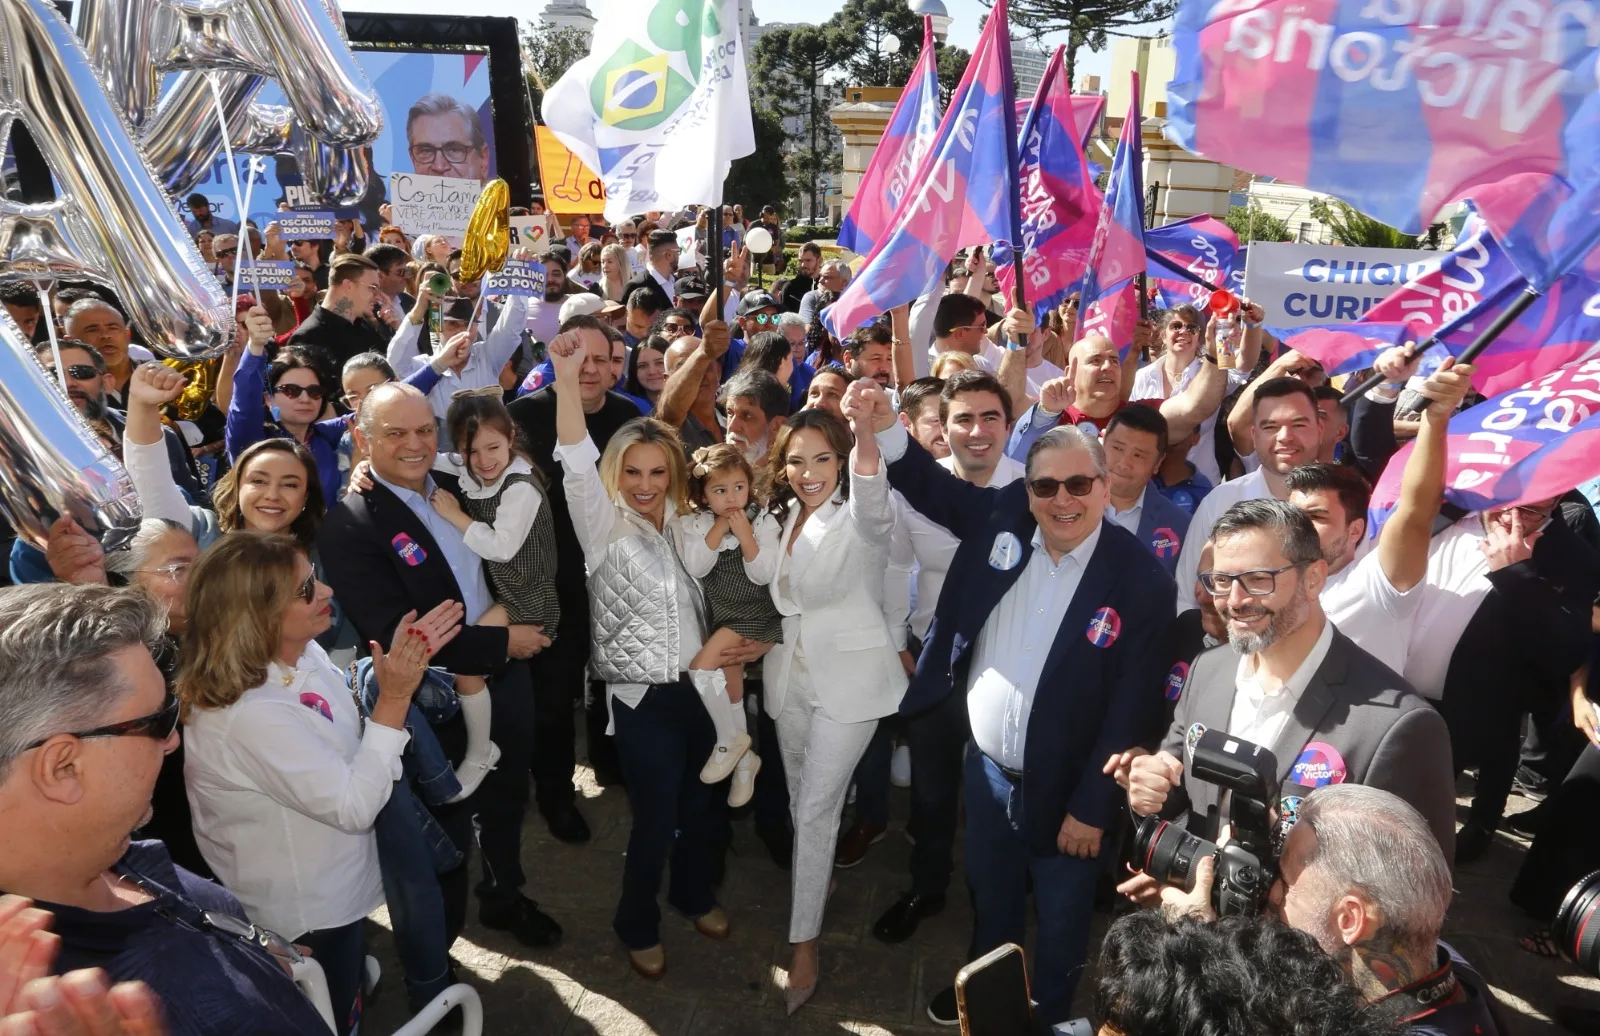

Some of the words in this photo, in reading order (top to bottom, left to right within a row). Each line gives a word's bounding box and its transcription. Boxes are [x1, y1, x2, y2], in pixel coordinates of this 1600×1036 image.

[280, 219, 331, 227] OSCALINO
[489, 278, 509, 289] DO
[1295, 762, 1326, 774] Maria
[1303, 769, 1342, 779] Victoria
